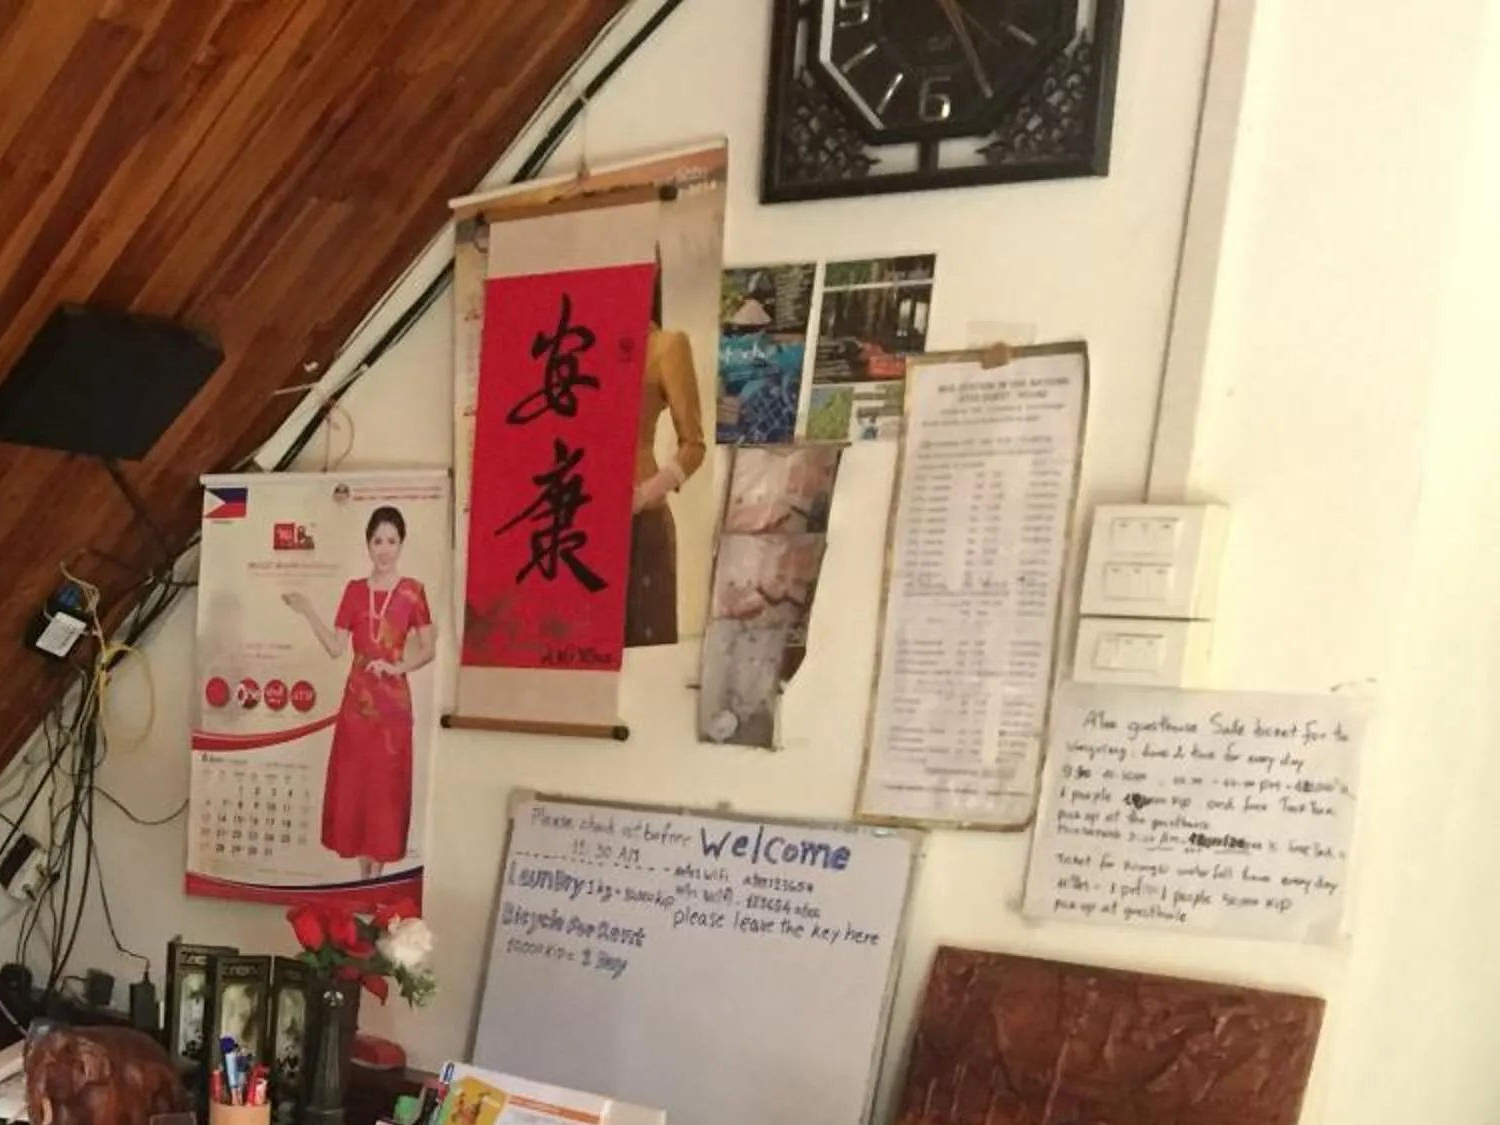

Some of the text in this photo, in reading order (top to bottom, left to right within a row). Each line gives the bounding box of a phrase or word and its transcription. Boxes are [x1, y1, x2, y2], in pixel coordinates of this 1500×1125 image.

[918, 75, 951, 122] 6
[531, 808, 574, 828] Please
[644, 822, 692, 846] before
[700, 824, 852, 871] Welcome
[674, 905, 880, 947] please leave the key here
